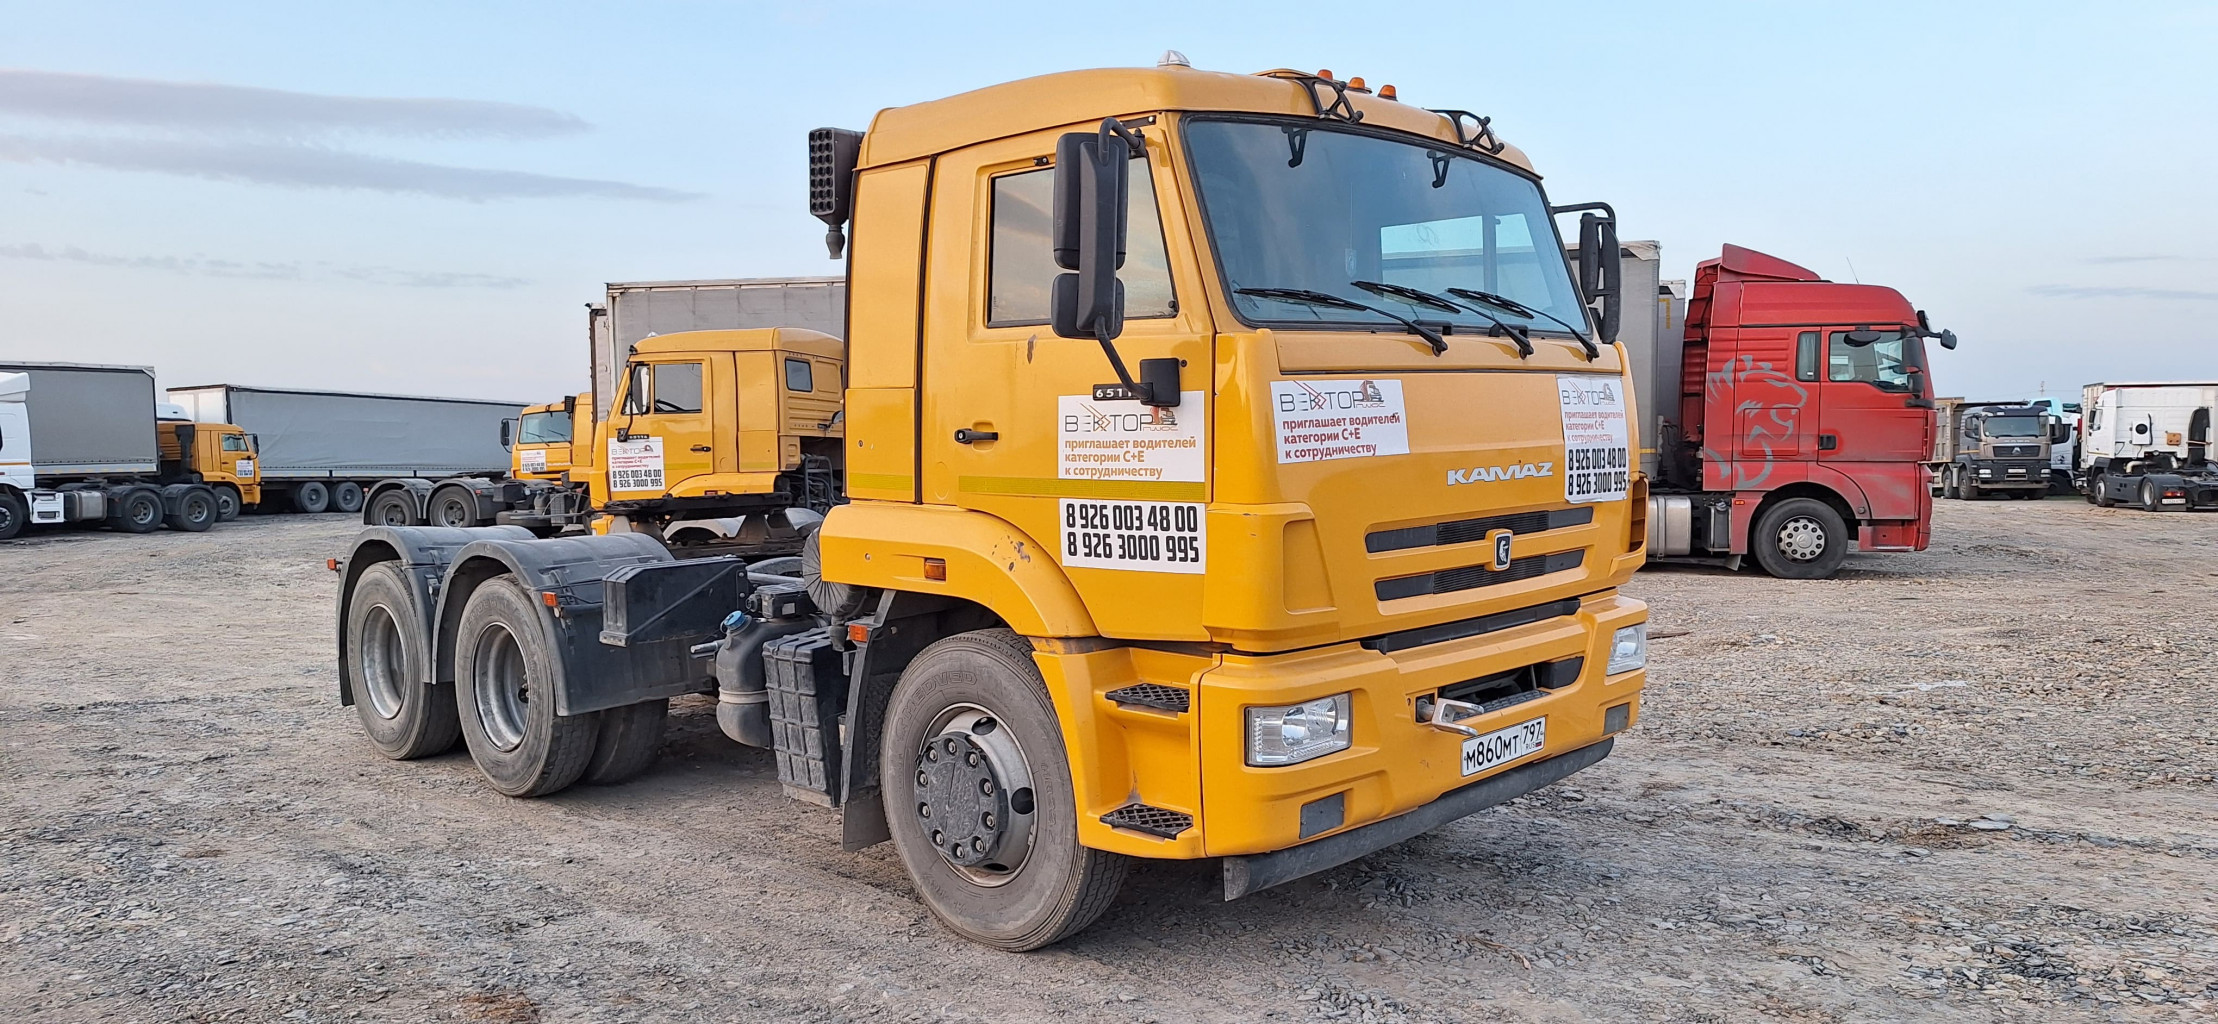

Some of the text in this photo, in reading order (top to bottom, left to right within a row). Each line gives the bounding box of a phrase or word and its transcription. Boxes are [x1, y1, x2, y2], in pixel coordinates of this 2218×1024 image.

[1280, 391, 1365, 412] ВЕКТОР
[1065, 413, 1153, 433] ВЕКТОР
[1282, 412, 1400, 432] приглашает водителей
[1564, 410, 1624, 421] приглашает водителей
[1566, 422, 1595, 433] категории
[1065, 436, 1196, 451] приглашает водителей
[1284, 431, 1340, 445] категории
[1065, 454, 1120, 465] категории
[1285, 444, 1377, 460] к сотрудничеству
[1568, 447, 1627, 471] 8 926 003 48 00
[613, 469, 662, 479] 8 926 003 48 00
[1065, 466, 1162, 479] к сотрудничеству
[1447, 462, 1553, 486] KAMAZ
[613, 478, 662, 488] 8 926 3000 995
[1568, 470, 1627, 496] 8 926 3000 995
[1066, 503, 1198, 532] 8 926 003 48 00
[1067, 532, 1199, 563] 8 926 3000 995
[1523, 721, 1542, 744] 797
